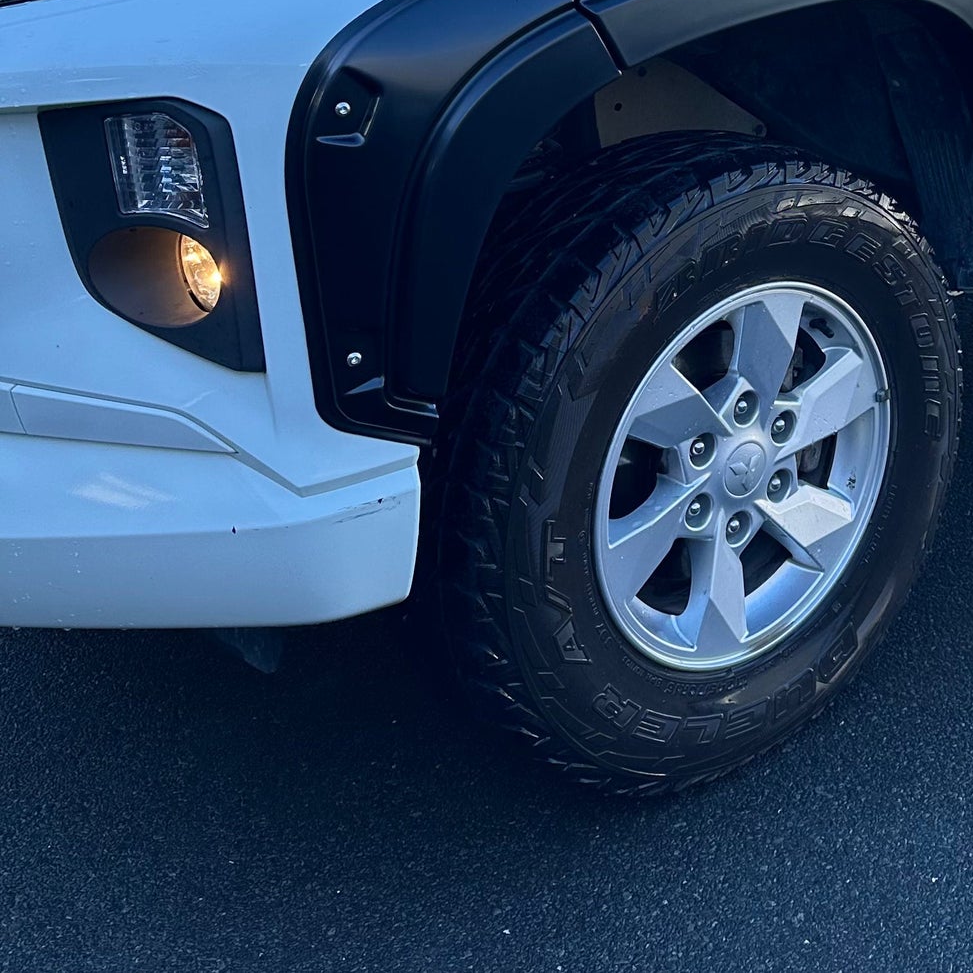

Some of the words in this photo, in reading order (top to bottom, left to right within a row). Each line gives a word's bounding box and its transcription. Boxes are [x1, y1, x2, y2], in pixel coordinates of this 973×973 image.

[654, 216, 942, 440] BRIDGESTONE
[543, 518, 593, 665] A/T
[591, 619, 858, 745] DUELER
